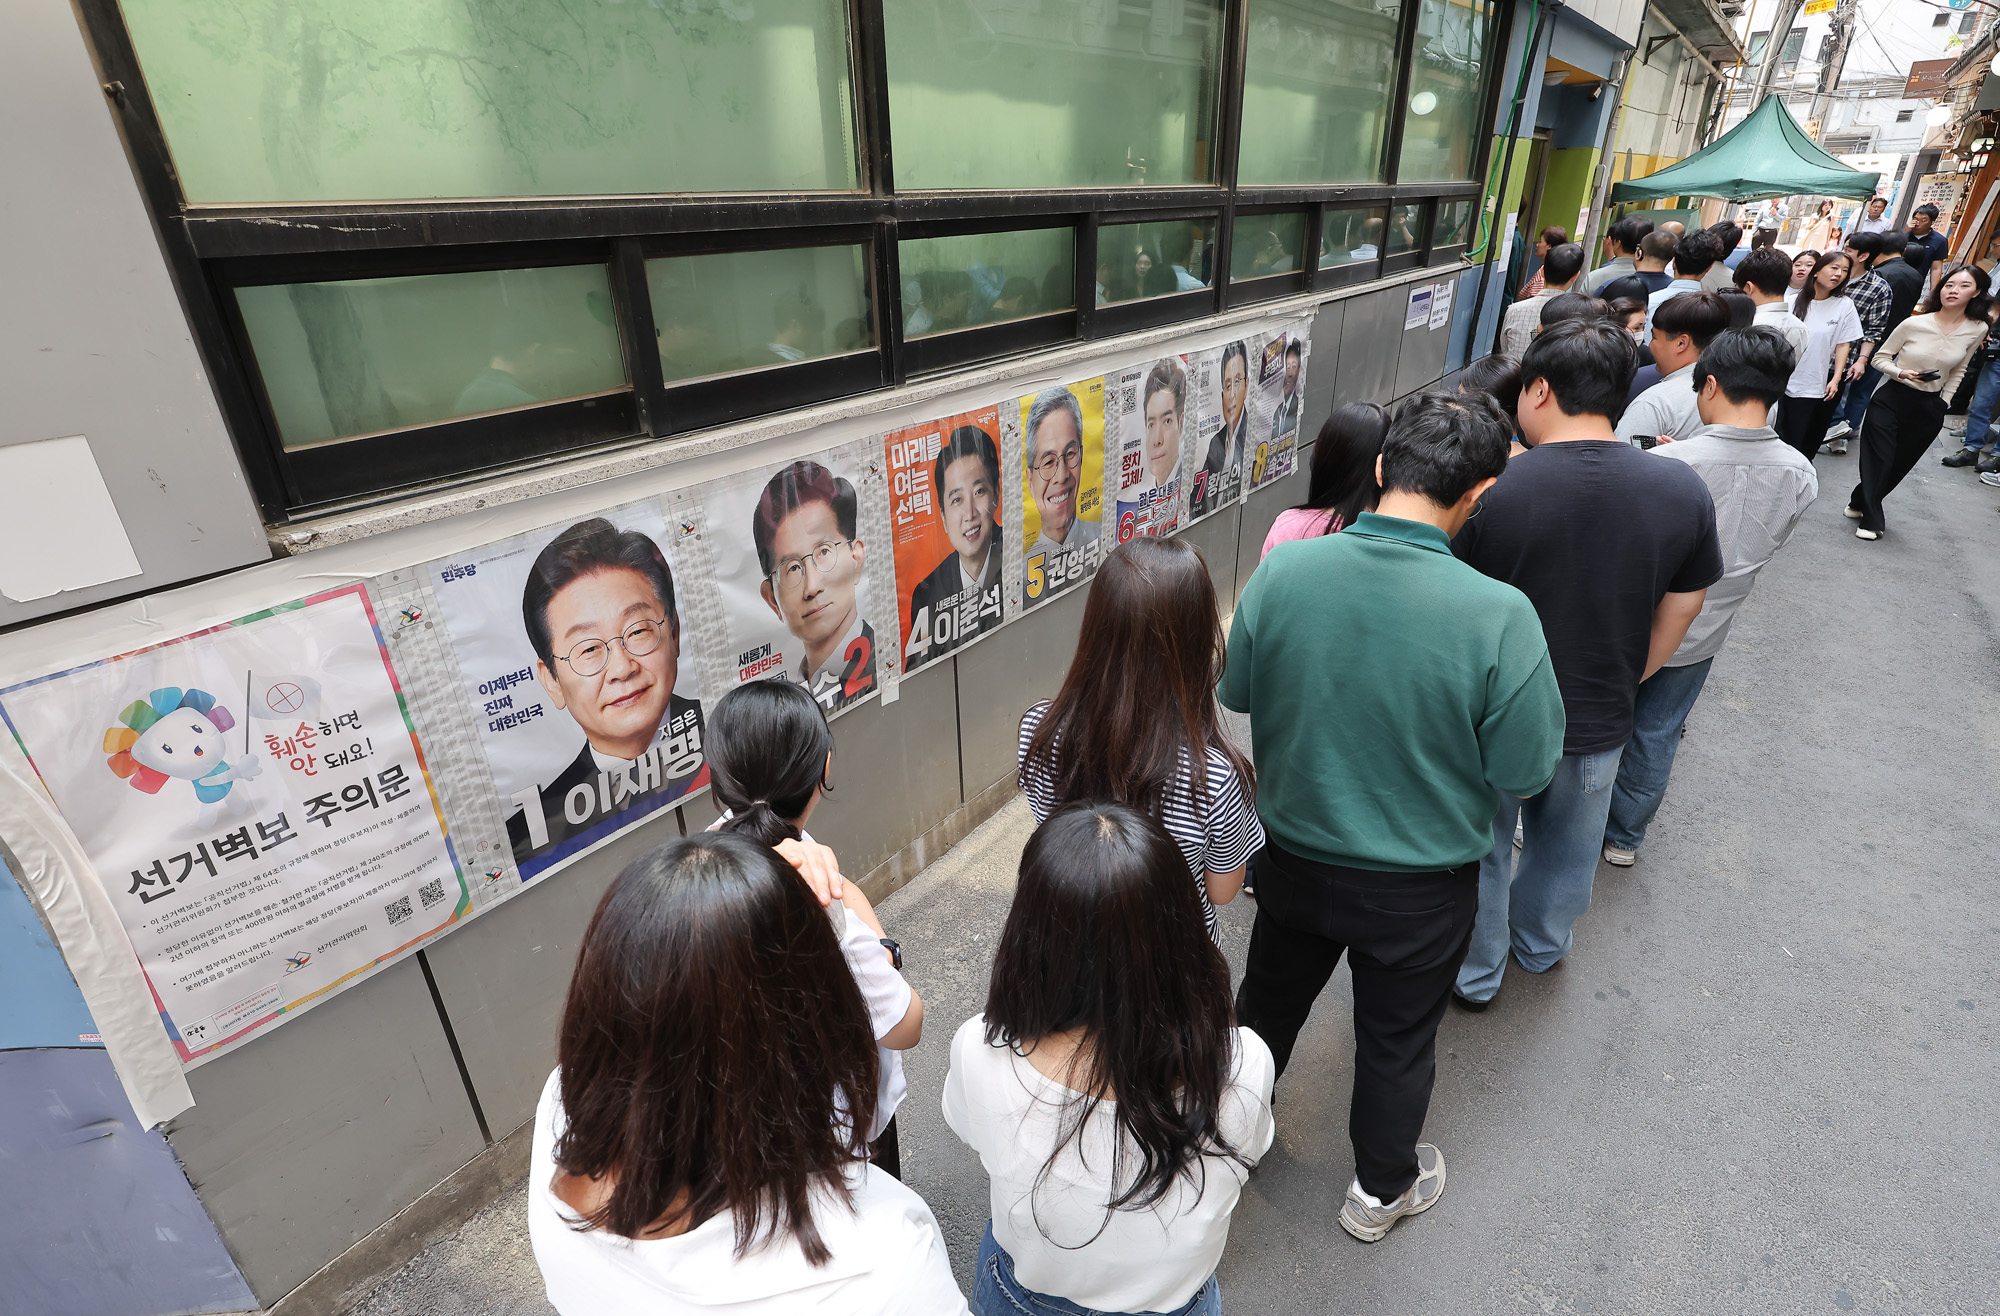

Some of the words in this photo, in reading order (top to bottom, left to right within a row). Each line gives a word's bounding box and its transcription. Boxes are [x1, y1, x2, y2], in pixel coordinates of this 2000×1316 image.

[891, 431, 942, 469] 미래를
[1122, 450, 1141, 472] 정치
[1252, 441, 1269, 483] 8
[894, 467, 929, 496] 여는
[1121, 467, 1144, 490] 교체!
[1194, 469, 1209, 504] 7
[1207, 461, 1240, 498] 황교안
[896, 490, 932, 525] 선택
[1118, 510, 1135, 544] 6
[440, 564, 477, 583] 민주당
[1026, 552, 1046, 599] 5
[1047, 538, 1100, 589] 권영국
[905, 605, 932, 658] 4
[934, 583, 1001, 645] 이준석
[934, 593, 959, 613] 새로운
[738, 642, 771, 667] 새롭게
[739, 652, 783, 682] 대한민국
[843, 635, 873, 698] 2
[478, 666, 534, 696] 이제부터
[483, 694, 513, 717] 진짜
[488, 703, 544, 733] 대한민국
[658, 708, 698, 741] 지금은
[263, 709, 363, 760] 훼손하면
[289, 754, 319, 777] 안
[323, 737, 375, 770] 돼요!
[509, 783, 550, 850] 1
[564, 724, 704, 825] 이재명
[127, 811, 298, 905] 선거벽보
[302, 763, 411, 828] 주의문
[150, 917, 159, 926] 이
[161, 900, 203, 922] 선거벽보는
[263, 863, 288, 879] 64조의
[288, 853, 310, 867] 규정에
[310, 843, 332, 857] 의하여
[333, 823, 379, 847] 정당(후보자)이
[164, 939, 190, 954] 정당한
[191, 925, 222, 942] 이유없이
[223, 908, 262, 929] 선거벽보를
[303, 884, 318, 895] 자는
[368, 848, 393, 864] 240조의
[394, 840, 412, 853] 규정에
[412, 829, 430, 843] 의하여
[155, 902, 222, 935] 선거관리위원회가
[248, 878, 282, 895] 것입니다.
[169, 953, 184, 963] 2년
[184, 941, 210, 955] 이하의
[210, 934, 227, 945] 징역
[227, 926, 244, 937] 또는
[244, 913, 275, 930] 400만원
[275, 904, 298, 917] 이하의
[299, 890, 326, 908] 벌금형에
[327, 879, 347, 893] 처벌을
[348, 873, 361, 883] 받게
[362, 865, 384, 877] 됩니다.
[179, 968, 204, 983] 여기에
[237, 940, 268, 958] 아니하는
[268, 924, 305, 944] 선거벽보는
[305, 916, 319, 926] 해당
[320, 895, 365, 919] 정당(후보자)이
[365, 881, 391, 897] 제출하지
[391, 869, 416, 885] 아니하여
[316, 924, 368, 954] 선거관리위원회
[185, 972, 225, 993] 못하였음을
[225, 951, 274, 975] 알려드립니다.
